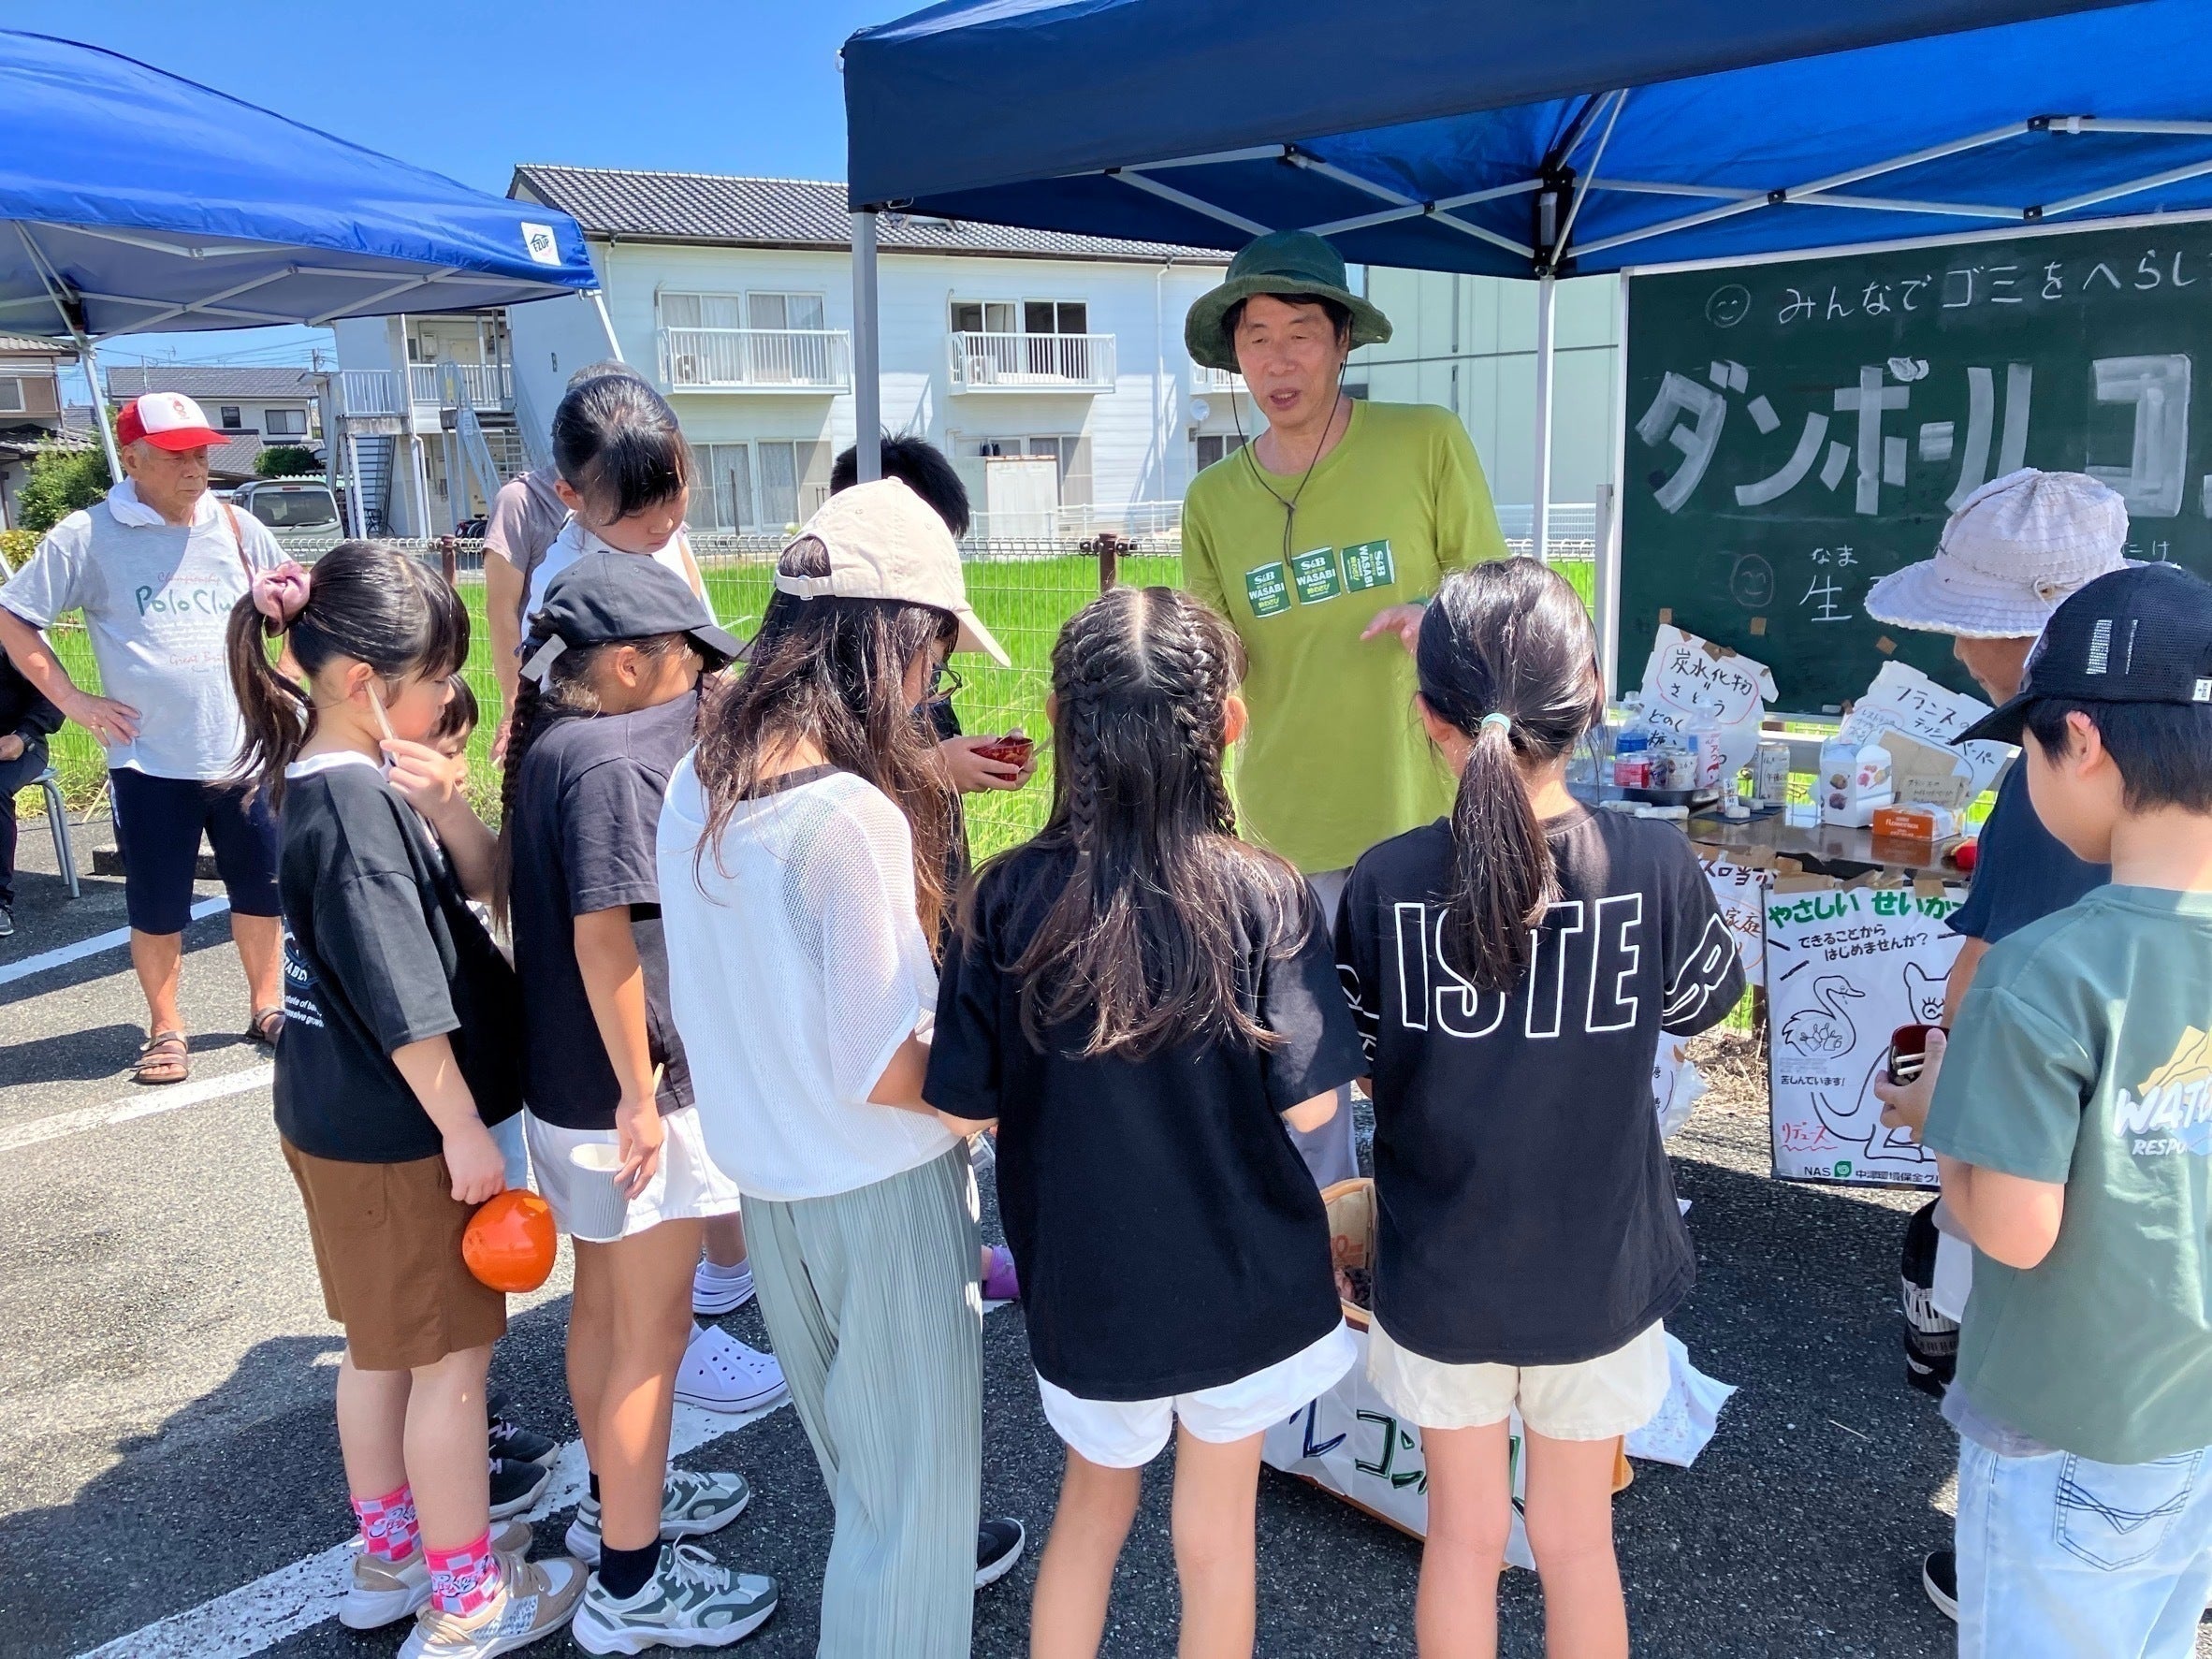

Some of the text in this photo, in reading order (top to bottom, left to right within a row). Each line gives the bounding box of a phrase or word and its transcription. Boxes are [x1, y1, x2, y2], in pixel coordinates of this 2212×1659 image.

[1778, 249, 2212, 325] みんなでゴミをへらし
[1635, 353, 2212, 518] ダンボールコ
[1359, 546, 1374, 587] WASABI
[1810, 545, 1858, 567] なま
[1249, 582, 1285, 600] WASABI
[1296, 568, 1336, 586] WASABI
[1798, 575, 1886, 622] 生
[1670, 648, 1753, 696] 炭水化物
[1768, 893, 1860, 930] やさしい
[1797, 924, 1886, 949] できることから
[1824, 932, 1928, 962] はじめませんか?
[1782, 1122, 1830, 1144] リデュース
[1804, 1166, 1831, 1177] NAS
